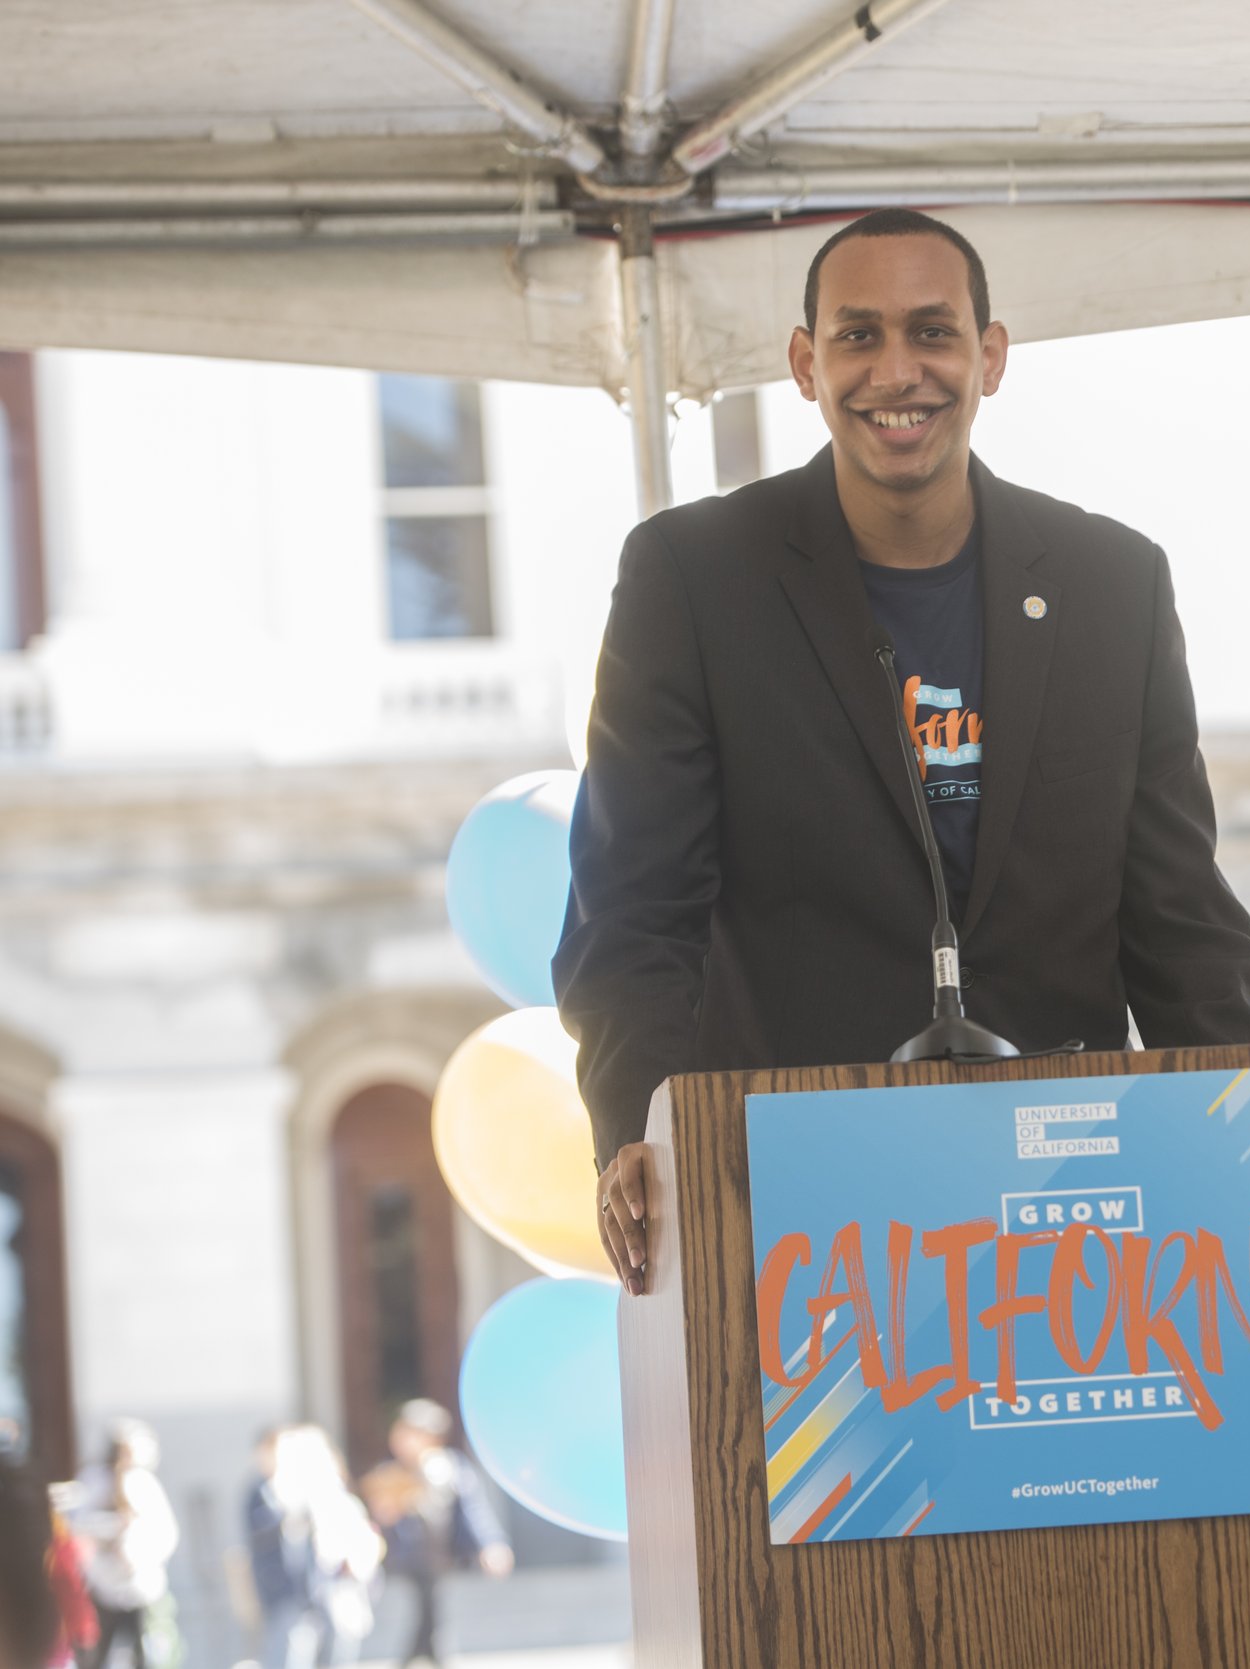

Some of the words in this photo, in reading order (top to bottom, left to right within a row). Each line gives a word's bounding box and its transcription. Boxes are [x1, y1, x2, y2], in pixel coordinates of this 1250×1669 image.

[913, 690, 953, 703] GROW
[940, 785, 956, 796] OF
[1018, 1105, 1112, 1121] UNIVERSITY
[1020, 1126, 1040, 1139] OF
[1020, 1140, 1115, 1156] CALIFORNIA
[1019, 1200, 1125, 1225] GROW
[985, 1386, 1183, 1416] TOGETHER
[1012, 1476, 1159, 1498] #GrowUCTogether
